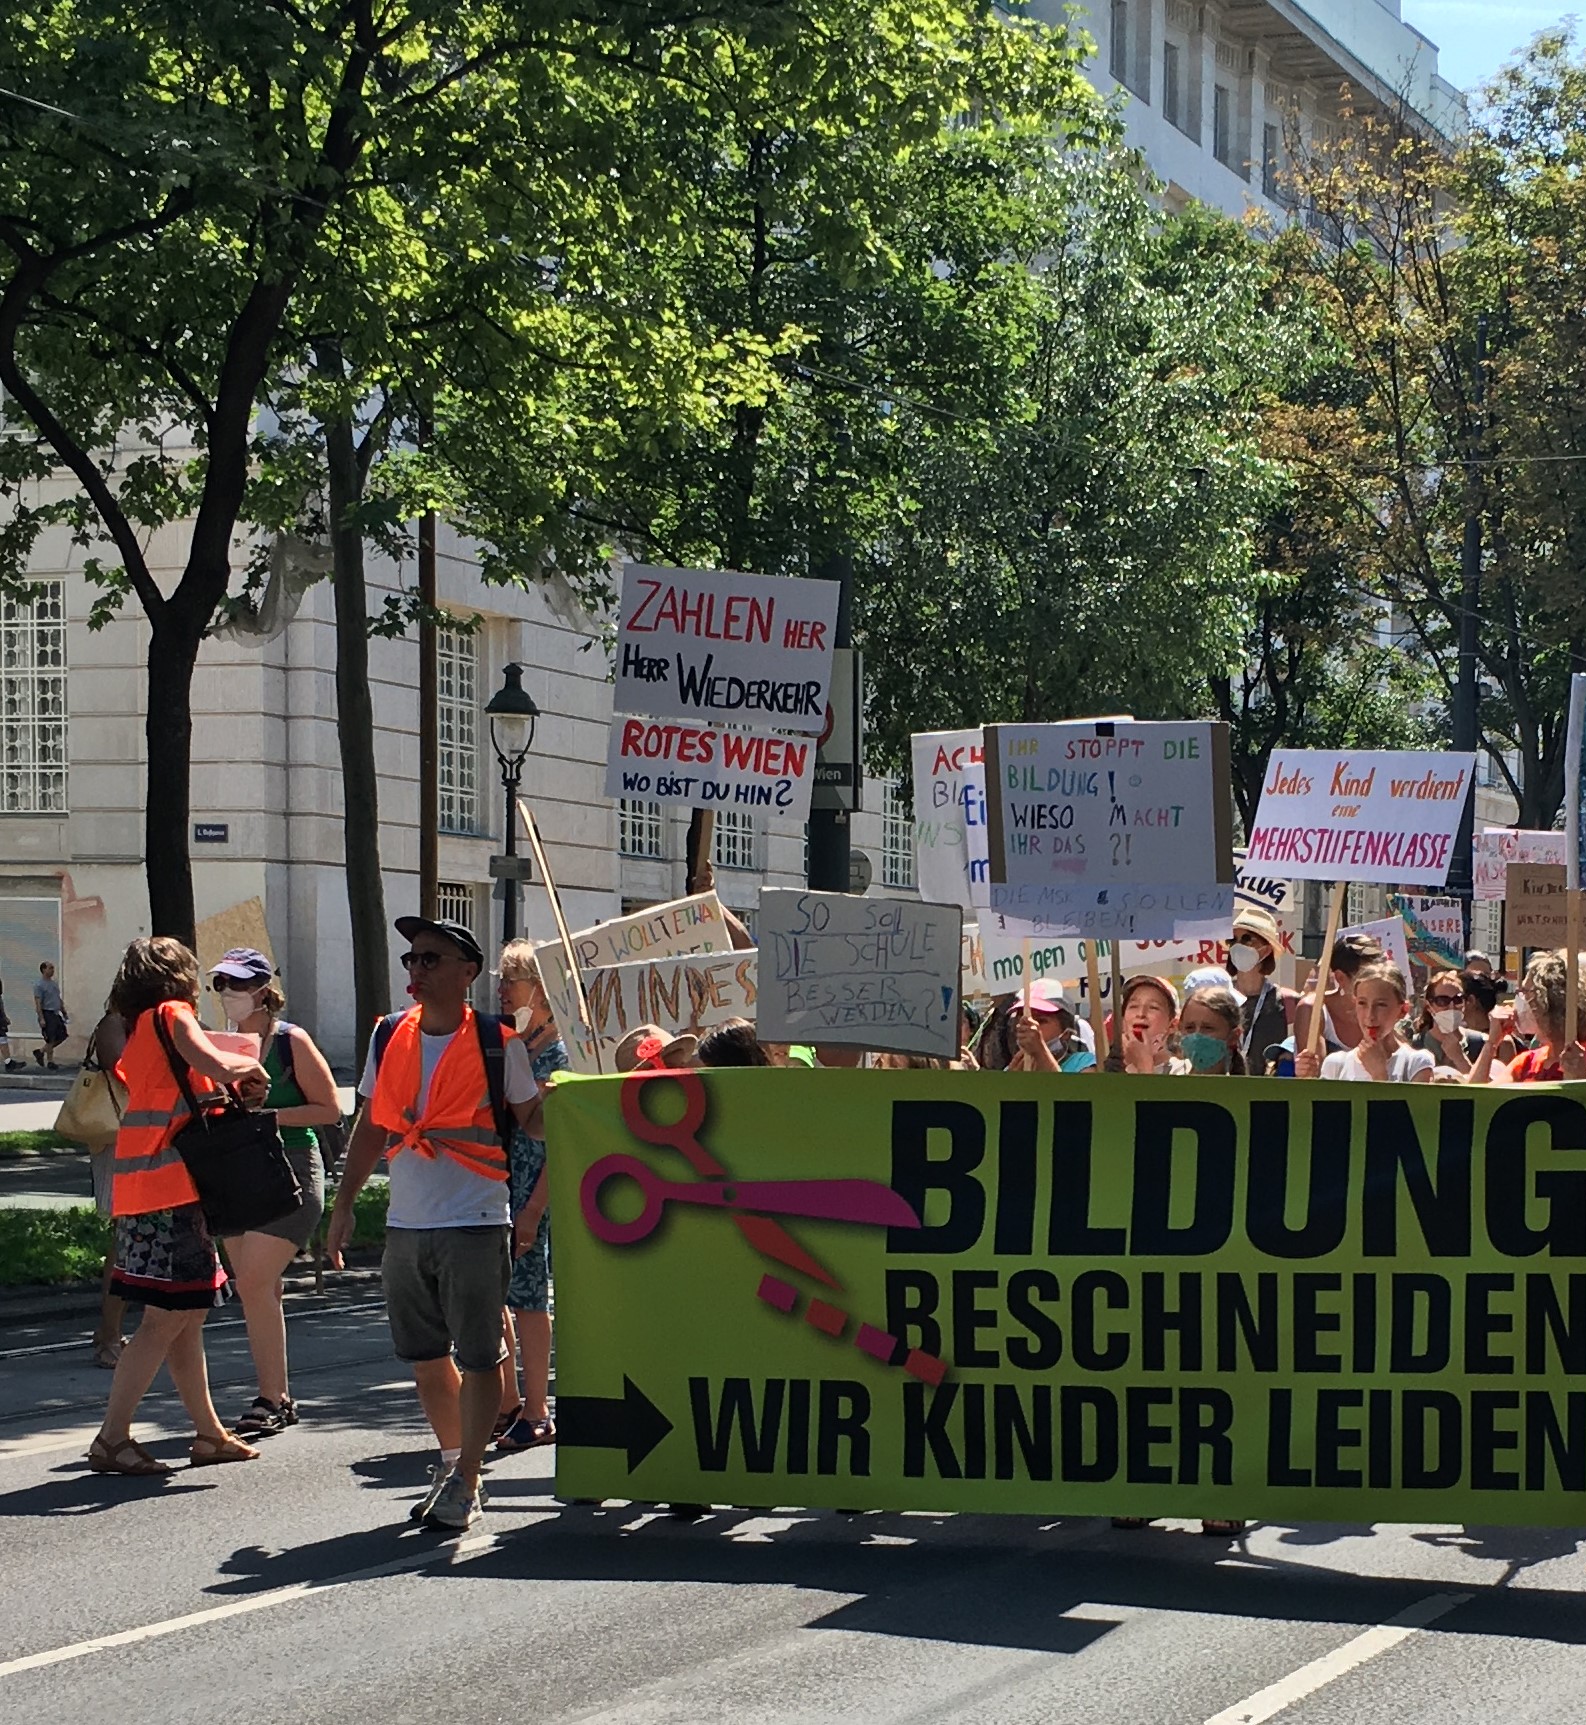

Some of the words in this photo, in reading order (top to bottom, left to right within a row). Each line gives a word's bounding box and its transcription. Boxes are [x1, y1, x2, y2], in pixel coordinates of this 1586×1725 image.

[626, 580, 775, 643] ZAHLEN
[783, 619, 826, 651] HER
[622, 643, 670, 683] HERR
[676, 652, 822, 716] WIEDERKEHR
[621, 719, 717, 763] ROTES
[723, 733, 807, 777] WIEN
[1064, 739, 1144, 760] STOPPT
[1164, 737, 1199, 760] DIE
[623, 772, 650, 793] WO
[701, 780, 730, 800] DU
[1266, 761, 1314, 796] Jedes
[1330, 761, 1375, 798] Kind
[1391, 769, 1464, 800] verdient
[1010, 803, 1074, 830] WIESO
[1109, 803, 1184, 827] MACHT
[1331, 804, 1361, 818] eine
[1011, 834, 1042, 855] IHR
[1053, 834, 1086, 855] DAS
[1249, 827, 1451, 869] MEHRSTUFENKLASSE
[787, 895, 830, 935] SO
[1114, 889, 1228, 912] SOLLEN
[609, 916, 672, 961] WOLLT
[769, 931, 818, 978] DIE
[846, 923, 937, 970] SCHULE
[993, 944, 1065, 982] mogen
[784, 977, 901, 1013] BESSER
[689, 1377, 871, 1476] WIR
[902, 1381, 1233, 1485] KINDER
